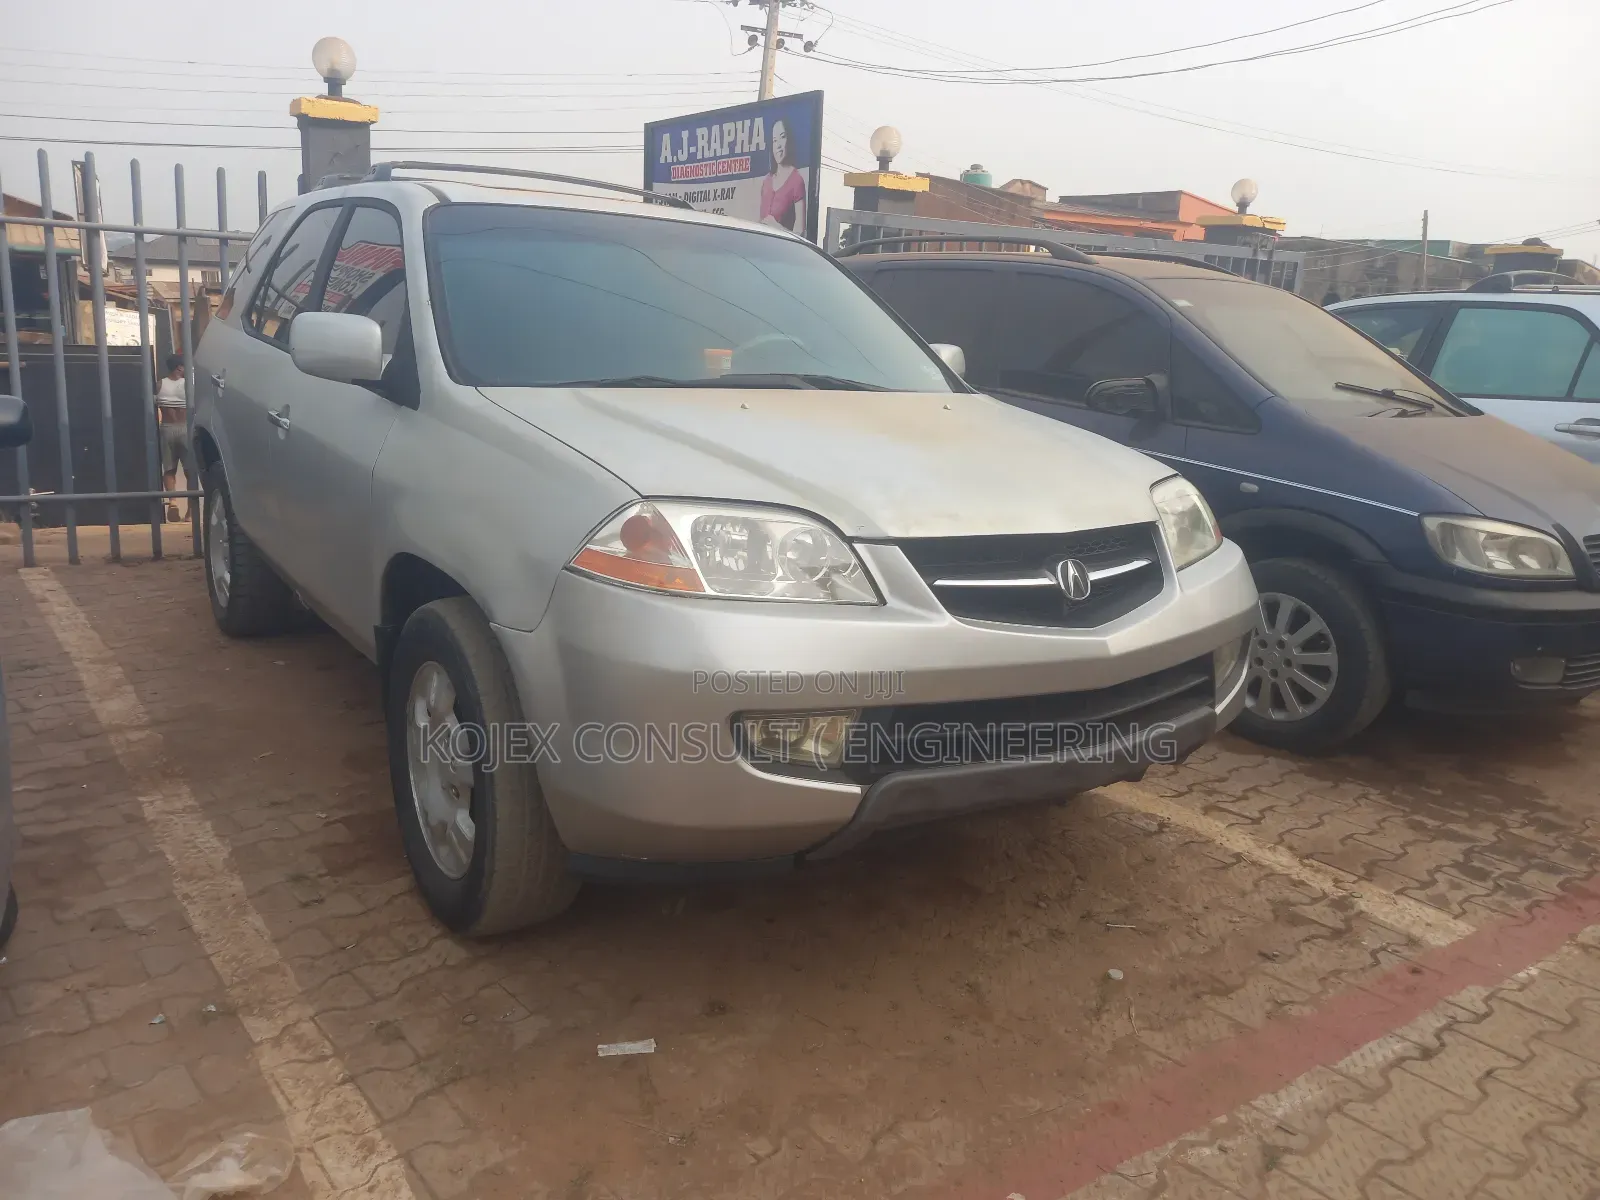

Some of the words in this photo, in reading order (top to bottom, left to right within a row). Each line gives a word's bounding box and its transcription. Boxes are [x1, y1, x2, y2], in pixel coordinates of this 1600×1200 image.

[660, 117, 766, 163] A.J-RAPHA
[671, 161, 716, 181] DIAGNOSTIC
[717, 155, 750, 176] CENTRE
[684, 190, 711, 203] DIGITAL
[712, 187, 736, 201] X-RAY
